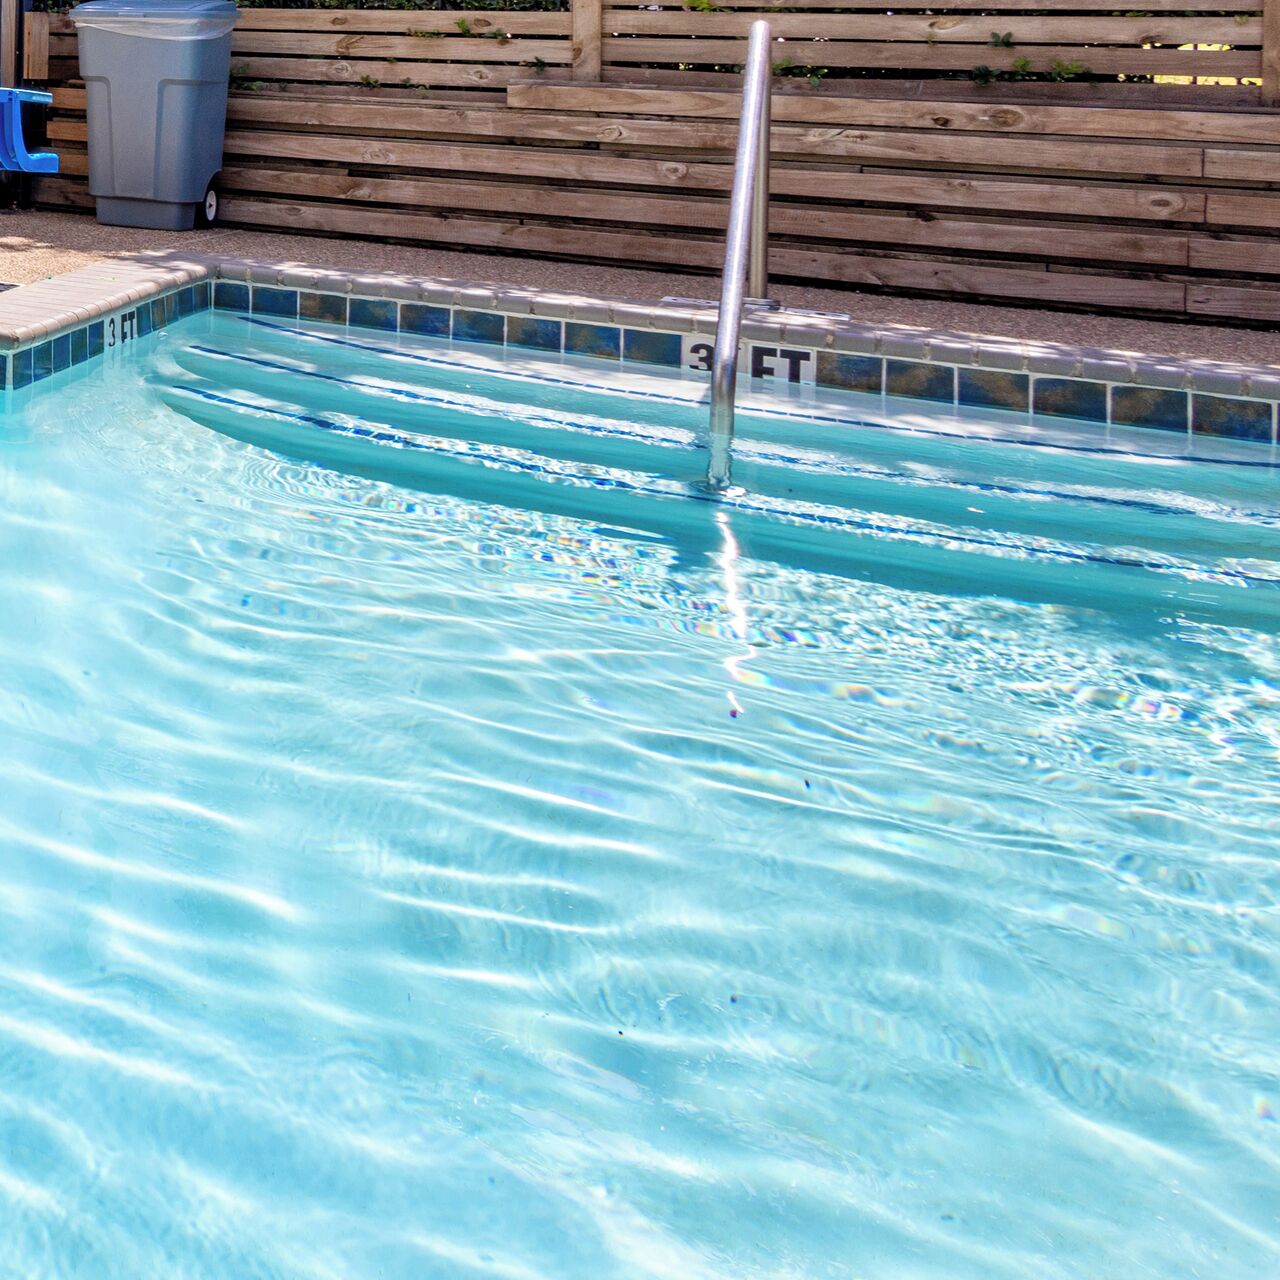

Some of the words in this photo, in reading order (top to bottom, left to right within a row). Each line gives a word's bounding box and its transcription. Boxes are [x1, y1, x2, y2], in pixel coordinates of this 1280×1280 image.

[108, 317, 116, 347] 3
[120, 310, 136, 344] FT
[689, 343, 714, 371] 3
[751, 345, 811, 383] FT
